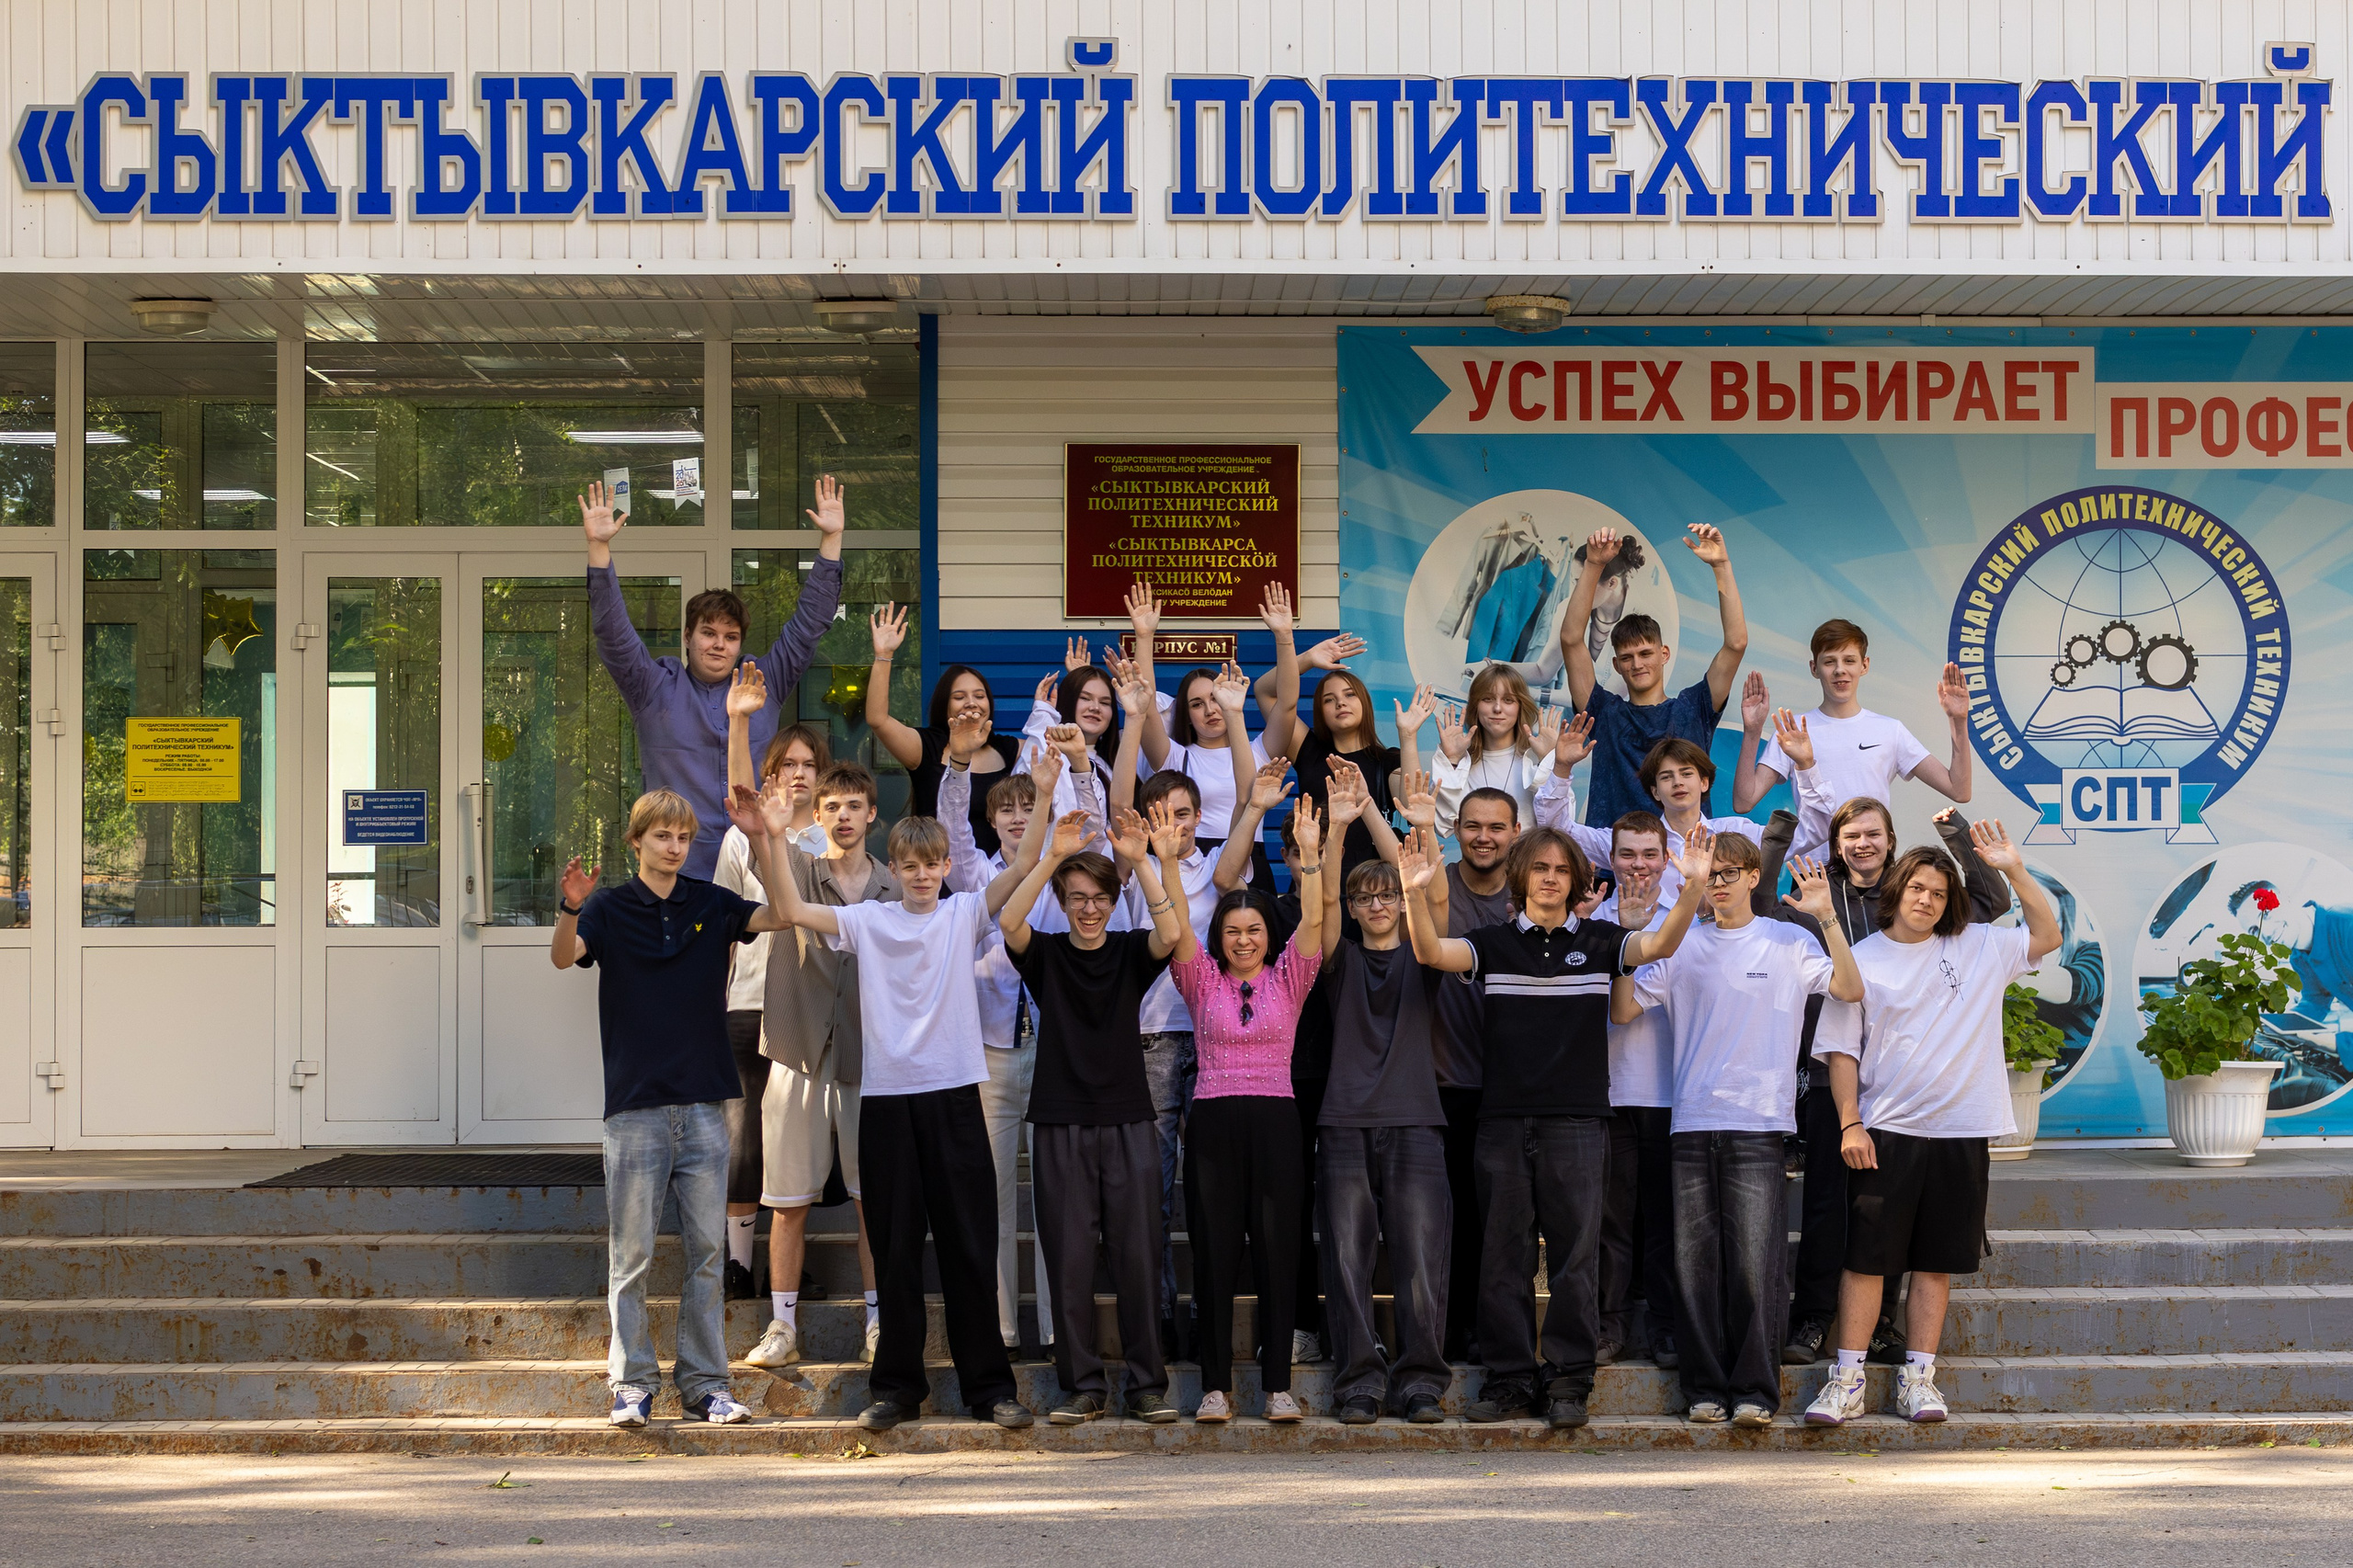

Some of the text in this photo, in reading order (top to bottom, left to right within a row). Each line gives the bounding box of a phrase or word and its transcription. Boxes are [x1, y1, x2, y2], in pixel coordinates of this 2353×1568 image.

[14, 39, 2333, 222] «СЫКТЫВКАРСКИЙ ПОЛИТЕХНИЧЕСКИЙ
[1462, 359, 2080, 422] УСПЕХ ВЫБИРАЕТ
[2110, 396, 2353, 458] ПРОФЕ
[1094, 456, 1272, 465] ГОСУДАРСТВЕННОЕ ПРОФЕССИОНАЛЬНОЕ
[1111, 465, 1255, 474] ОБРАЗОВАТЕЛЬНОЕ УЧРЕЖДЕНИЕ
[1091, 478, 1270, 494] «СЫКТЫВКАРСКИЙ
[1087, 495, 1279, 512] ПОЛИТЕХНИЧЕСКИЙ
[1130, 515, 1241, 528] ТЕХНИКУМ»
[1108, 538, 1257, 551] «СЫКТЫВКАРСА
[1132, 571, 1241, 585] ТЕХНИКУМ»
[1168, 598, 1228, 608] УЧРЕЖДЕНИЕ
[2040, 493, 2280, 620] ПОЛИТЕХНИЧЕСКИЙ
[2216, 628, 2282, 771] ТЕХНИКУМ
[1131, 641, 1228, 653] РПУС №1
[2071, 776, 2172, 823] СПТ
